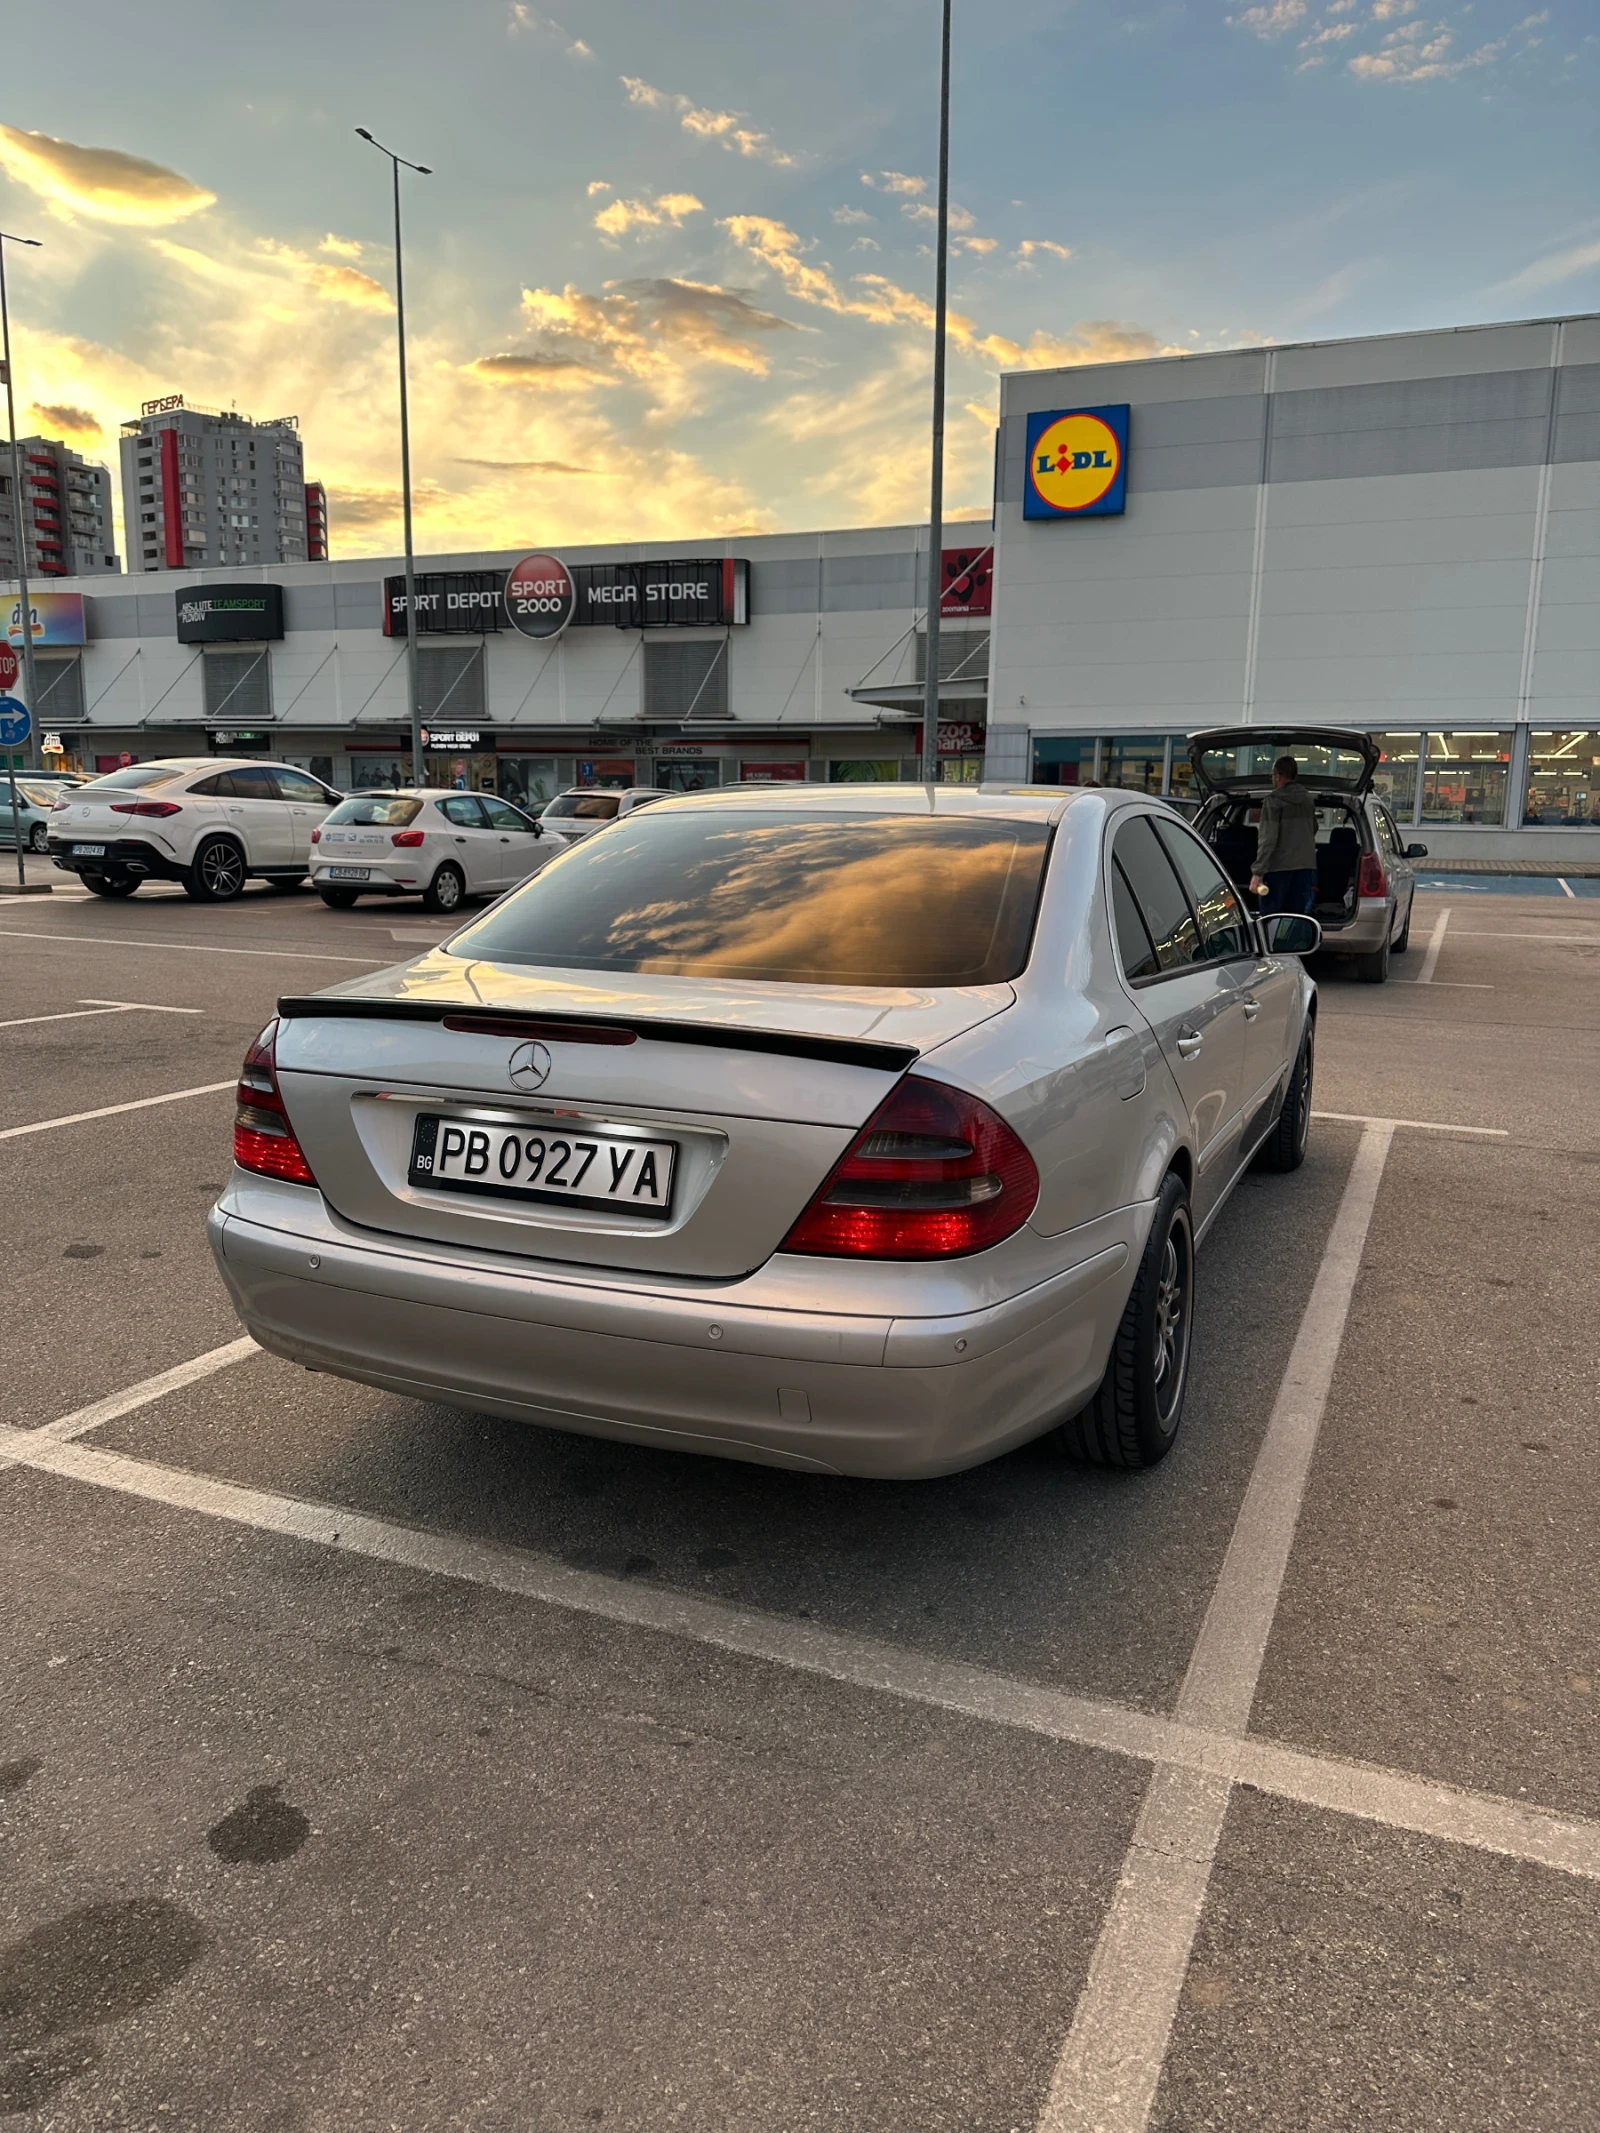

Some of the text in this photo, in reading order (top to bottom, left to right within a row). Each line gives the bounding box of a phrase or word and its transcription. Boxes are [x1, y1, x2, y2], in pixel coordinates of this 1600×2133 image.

[141, 394, 184, 415] ГЕРБЕРА
[511, 579, 566, 596] SPORT
[588, 582, 709, 603] MEGA STORE
[447, 591, 502, 610] DEPOT
[516, 597, 562, 614] 2000
[182, 612, 206, 623] PLOVDIV
[0, 656, 15, 674] TOP
[430, 733, 455, 742] SPORT
[456, 731, 480, 742] DEPOT
[589, 739, 653, 747] HOME OF THE
[635, 747, 703, 755] BEST BRANDS
[416, 1154, 433, 1171] BG
[440, 1127, 659, 1198] PB 0927 YA
